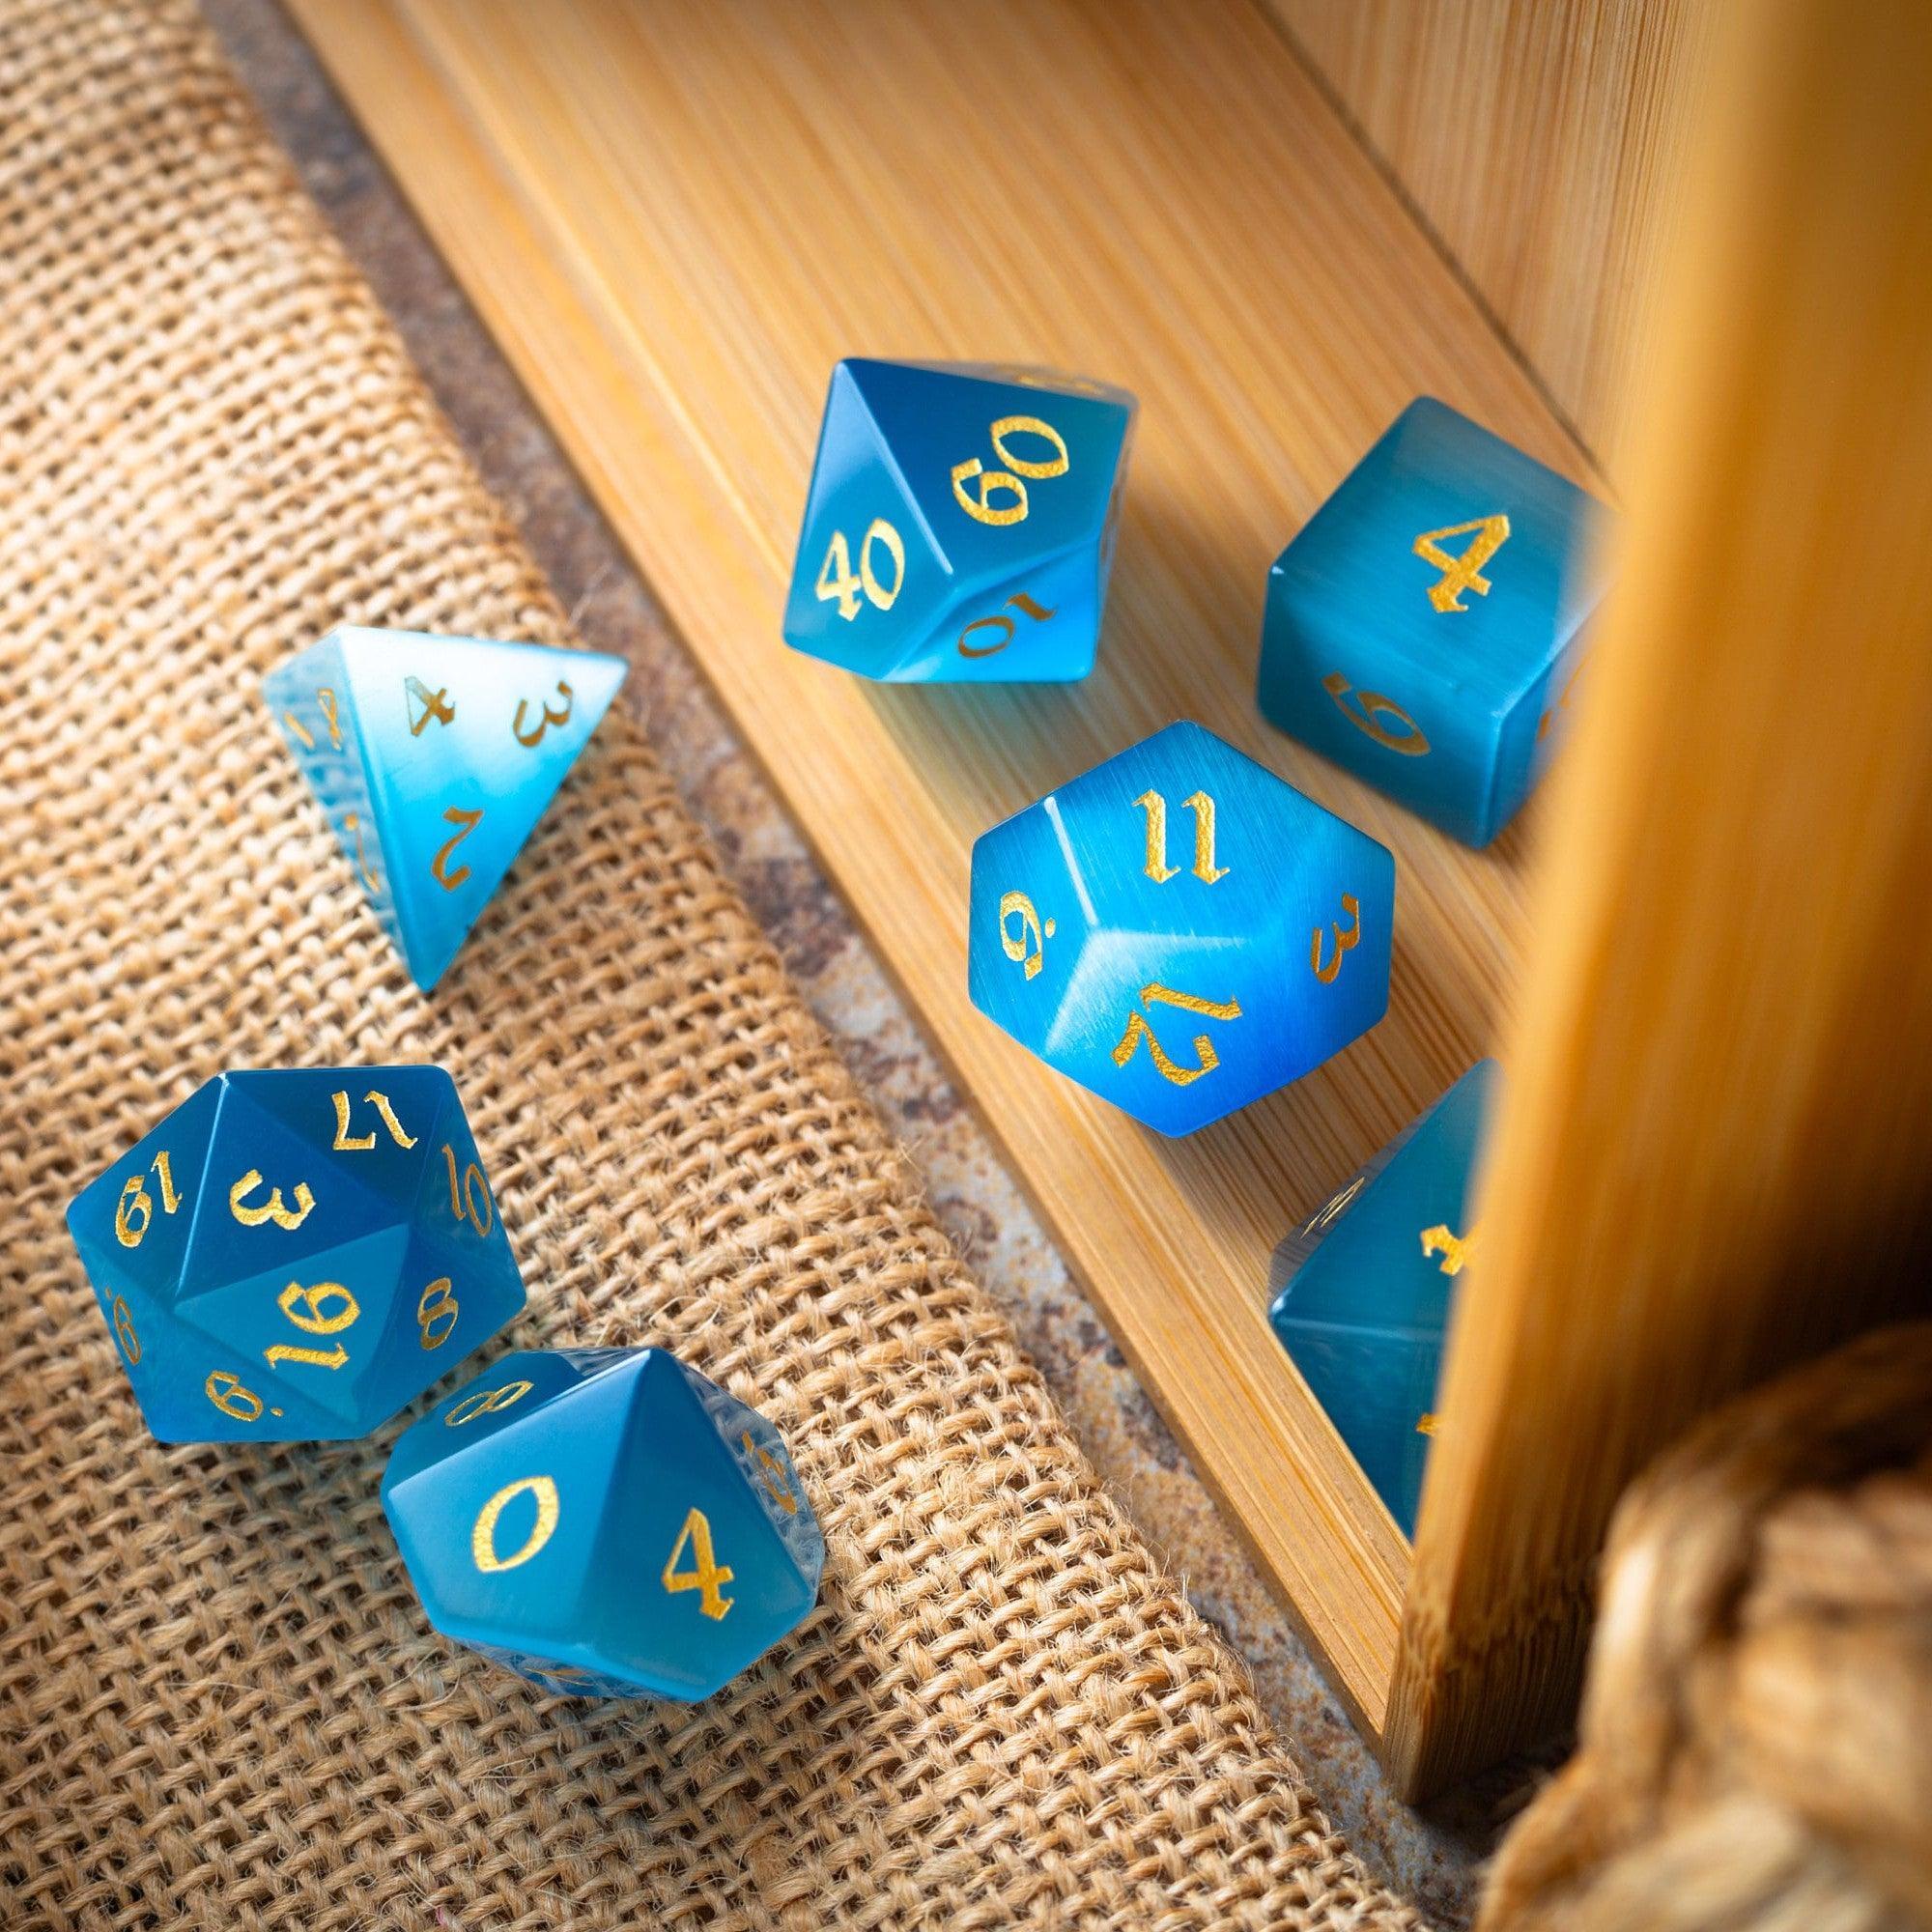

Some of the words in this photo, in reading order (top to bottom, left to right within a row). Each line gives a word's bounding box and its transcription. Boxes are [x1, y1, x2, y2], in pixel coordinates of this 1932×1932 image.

[952, 414, 1069, 526] 60
[815, 517, 905, 622] 40
[1413, 514, 1512, 613] 4
[957, 591, 1057, 659] 10
[404, 675, 456, 737] 4
[512, 680, 573, 748] 3
[431, 805, 484, 893] 2
[1131, 788, 1231, 885] 11
[1311, 892, 1361, 985] 3
[1111, 981, 1243, 1087] 12
[330, 1090, 419, 1151] 17
[114, 1150, 184, 1249] 19
[229, 1168, 317, 1231] 3
[441, 1143, 493, 1237] 10
[263, 1280, 361, 1370] 16
[416, 1277, 460, 1351] 8
[443, 1379, 535, 1428] 8
[661, 1506, 735, 1622] 4
